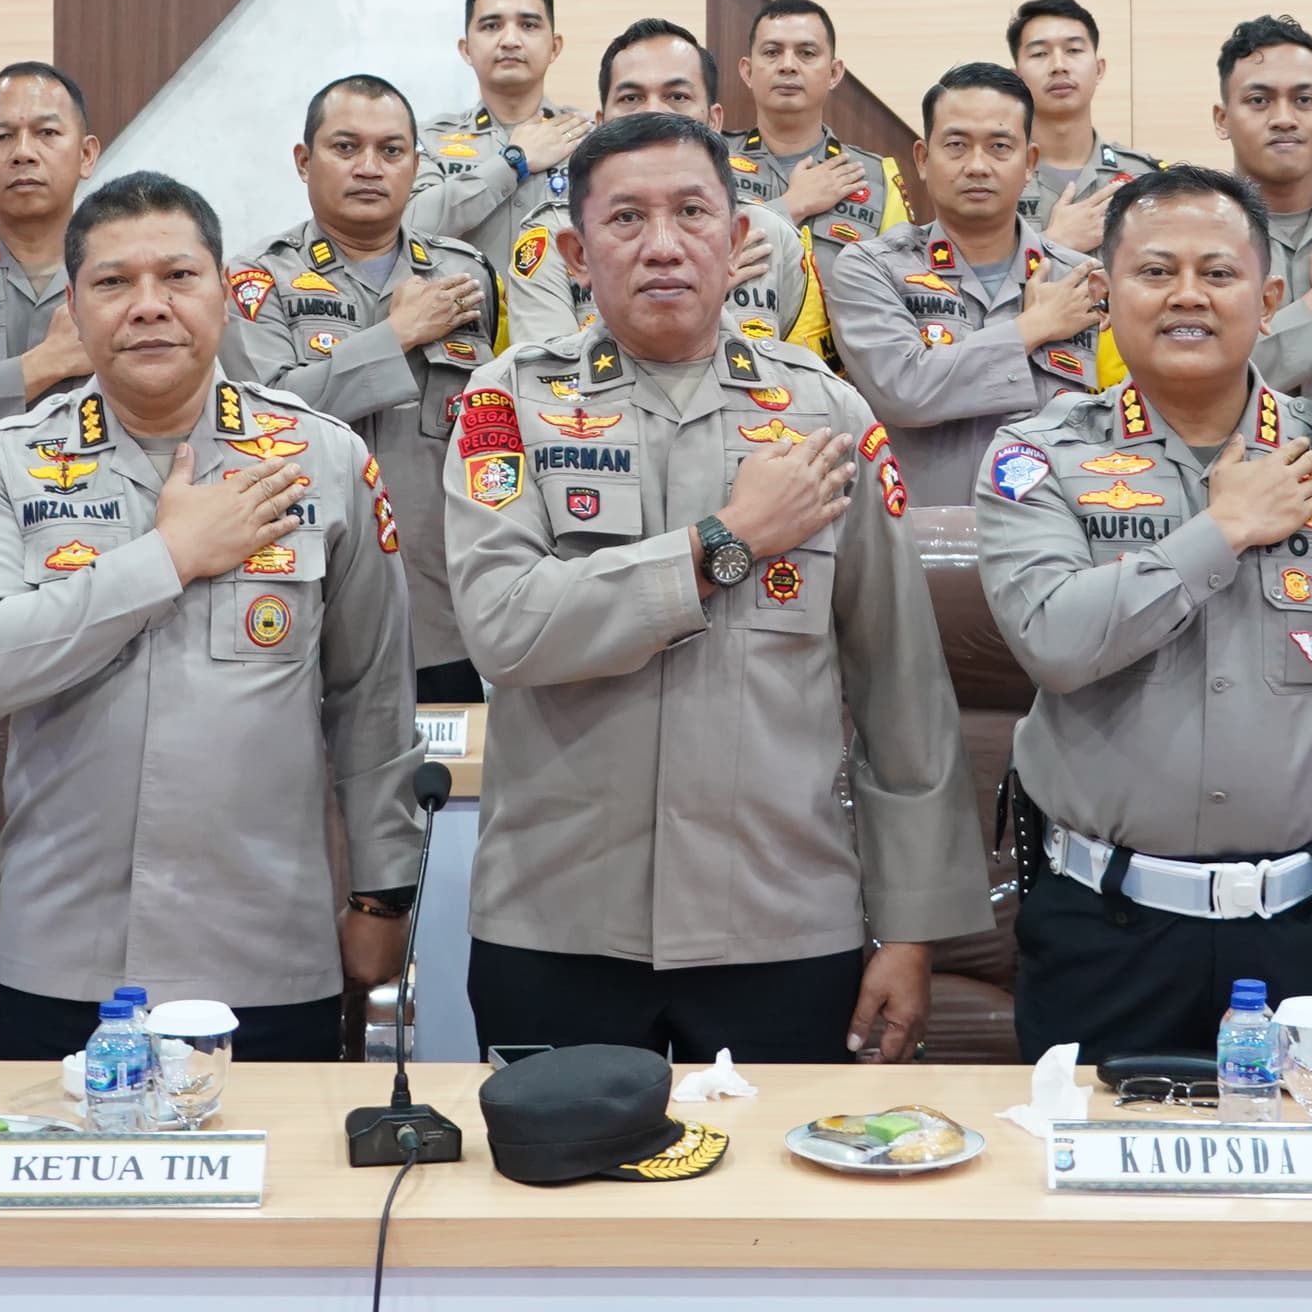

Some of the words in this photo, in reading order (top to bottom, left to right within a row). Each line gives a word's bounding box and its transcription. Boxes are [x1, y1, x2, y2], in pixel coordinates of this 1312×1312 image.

[535, 446, 631, 473] HERMAN
[23, 500, 78, 527] MIRZAL
[84, 501, 121, 520] ALWI
[10, 1155, 145, 1181] KETUA
[160, 1155, 231, 1181] TIM
[1119, 1136, 1296, 1175] KAOPSDA
